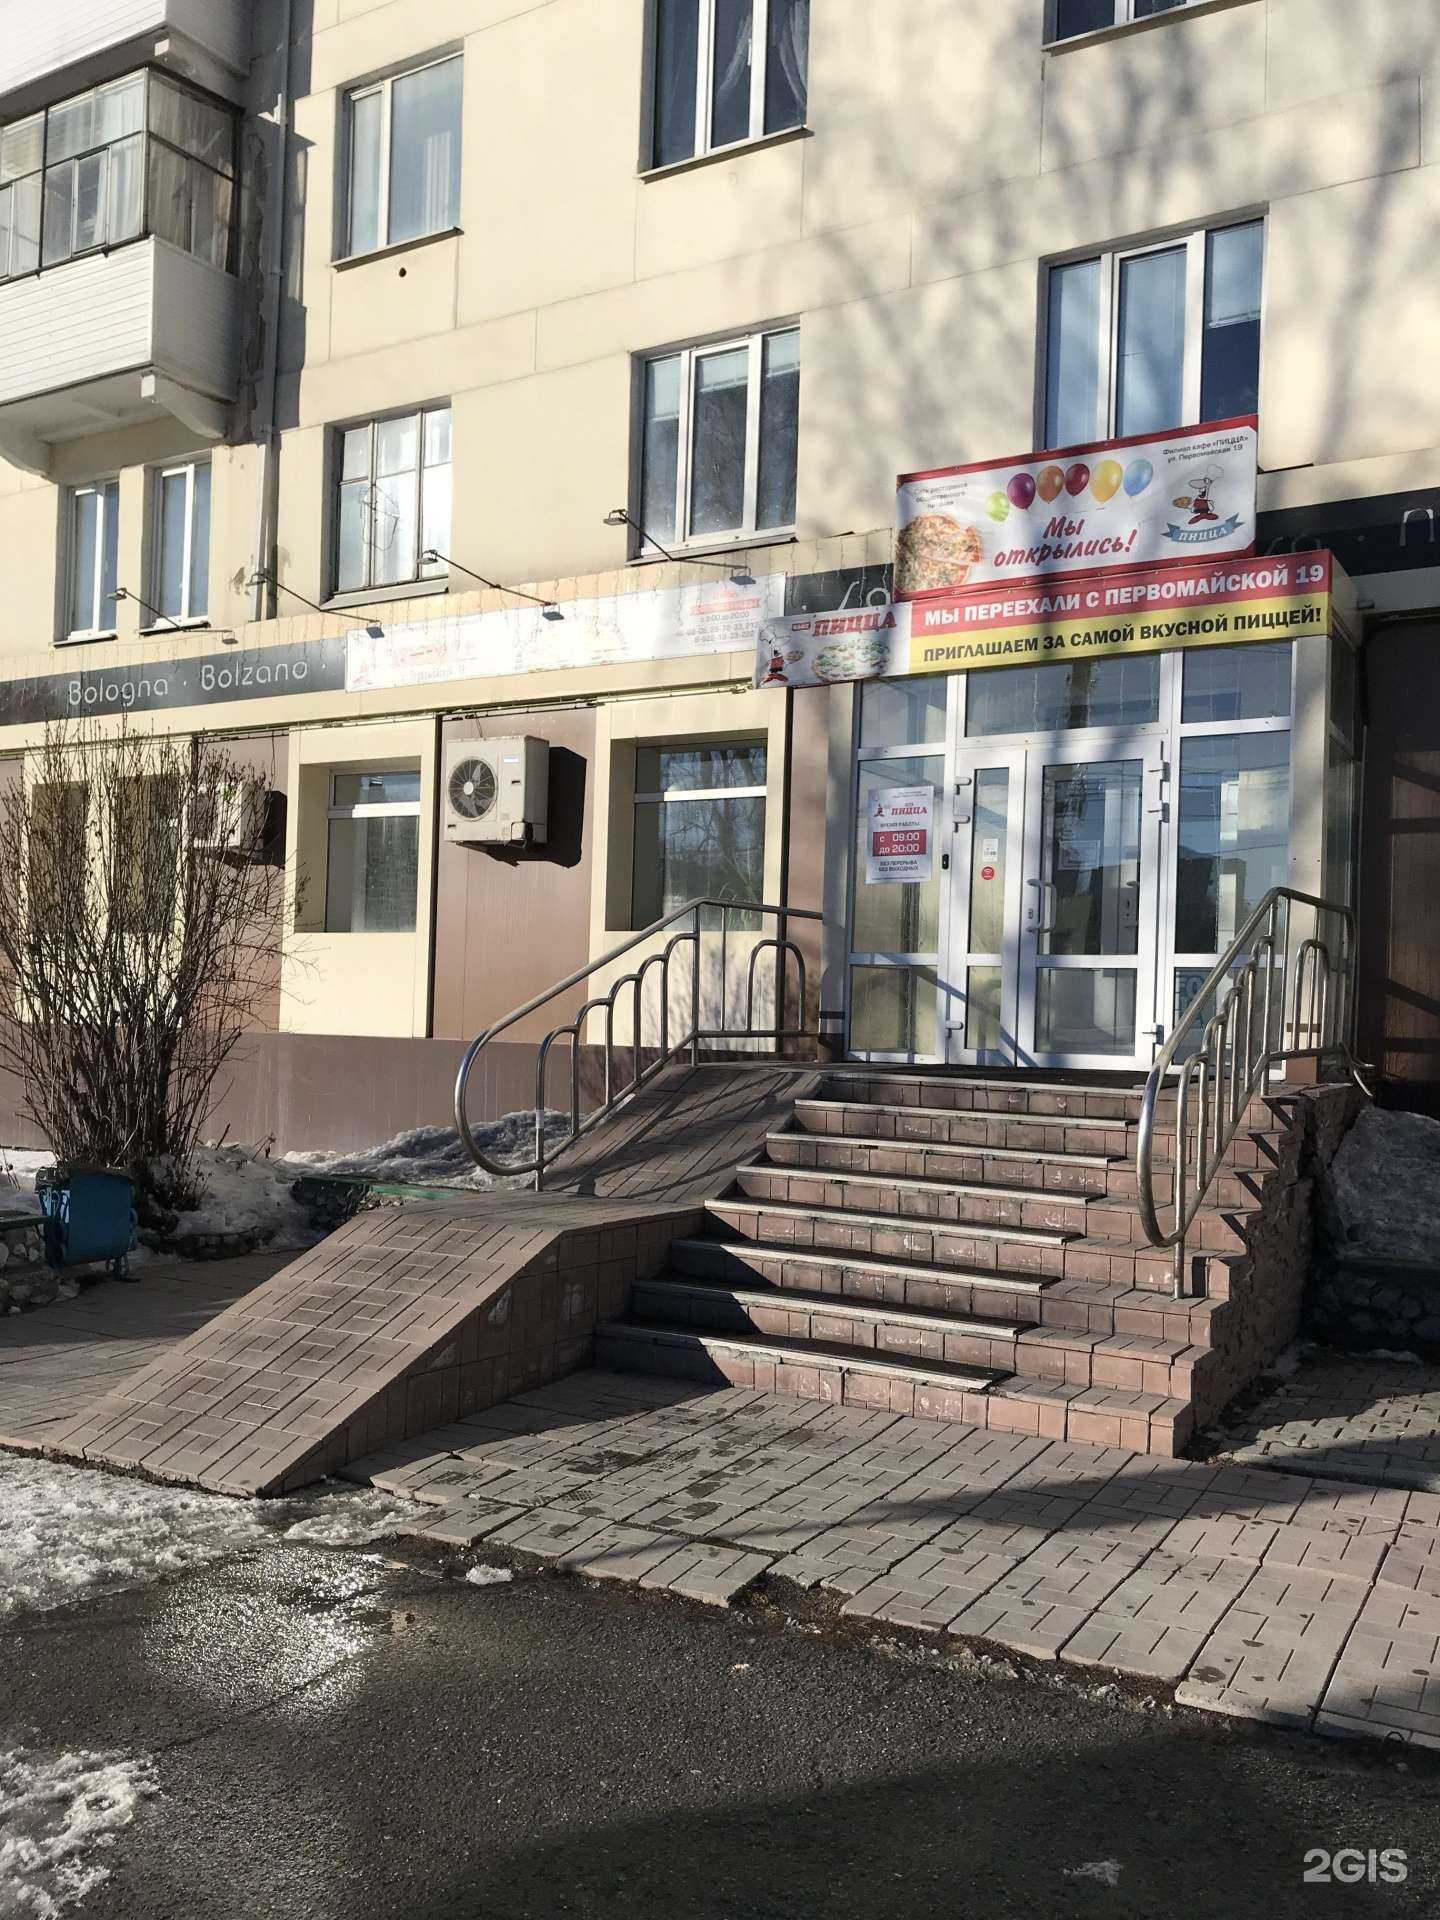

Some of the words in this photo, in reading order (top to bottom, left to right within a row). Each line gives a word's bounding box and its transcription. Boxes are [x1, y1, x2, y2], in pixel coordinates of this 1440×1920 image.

[1162, 446, 1191, 456] Филиал
[1192, 443, 1212, 452] кафе
[1043, 516, 1085, 539] Мы
[1179, 526, 1229, 541] ПИЦЦА
[993, 529, 1138, 567] открылись!
[925, 609, 958, 626] МЫ
[964, 593, 1080, 622] ПЕРЕЕХАЛИ
[1085, 591, 1100, 608] С
[1105, 563, 1289, 606] ПЕРВОМАЙСКОЙ
[1295, 564, 1324, 584] 19
[812, 611, 897, 637] ПИЦЦА
[923, 637, 1038, 662] ПРИГЛАШАЕМ
[1043, 635, 1065, 649] ЗА
[1070, 623, 1135, 647] САМОЙ
[1140, 613, 1228, 640] ВКУСНОЙ
[1234, 603, 1322, 629] ПИЦЦЕЙ!
[68, 678, 169, 707] Bologna
[201, 659, 308, 691] Bolzano
[891, 806, 928, 816] ПИЦЦА
[892, 832, 920, 842] 09:00
[879, 846, 890, 855] до
[891, 843, 920, 853] 20:00
